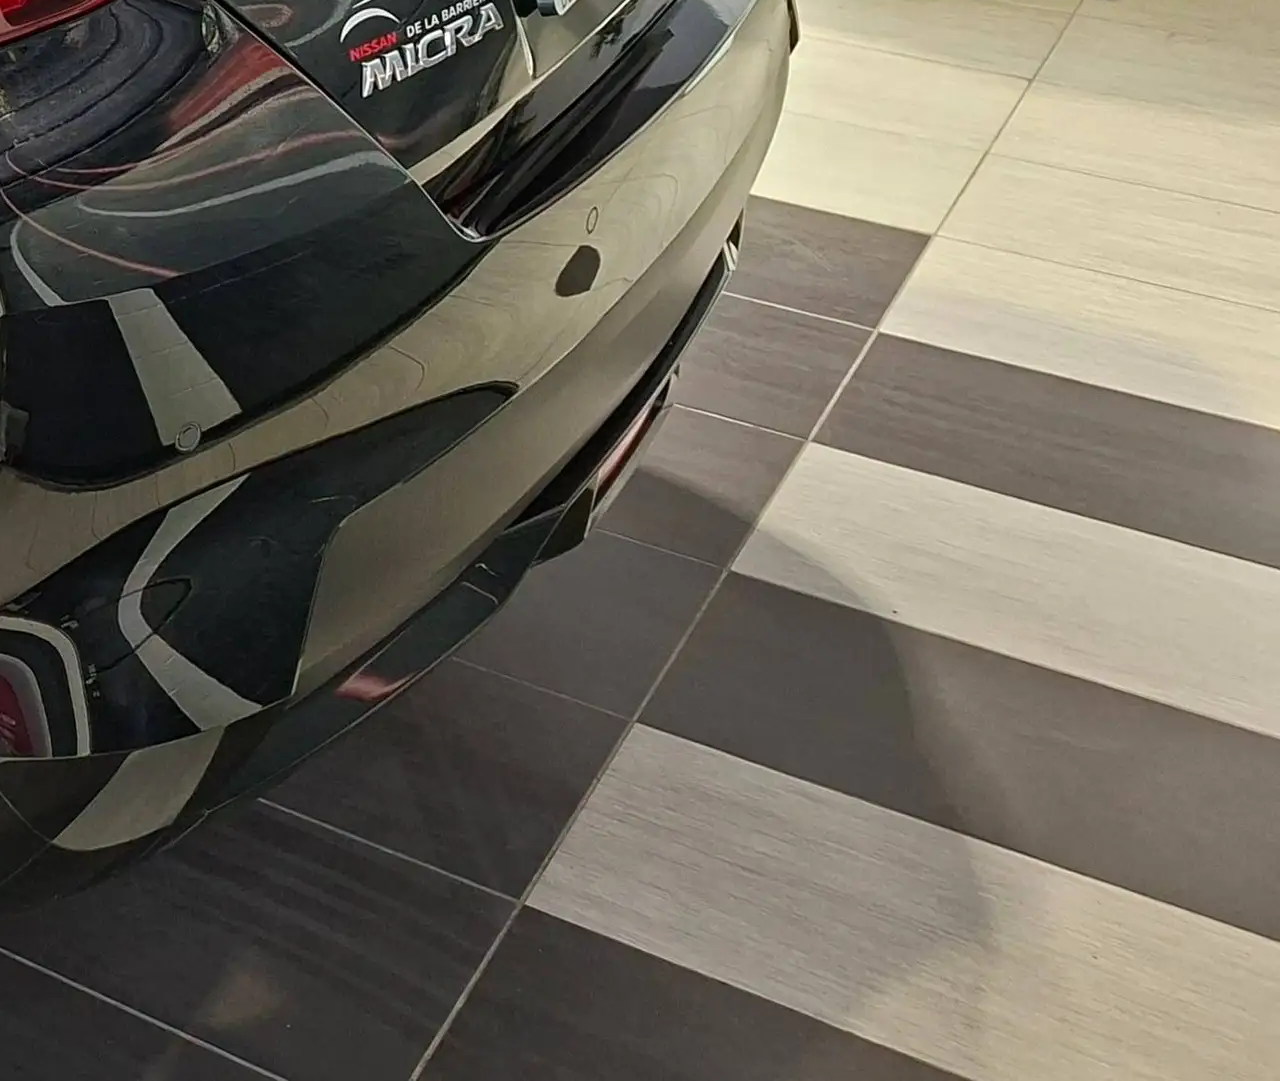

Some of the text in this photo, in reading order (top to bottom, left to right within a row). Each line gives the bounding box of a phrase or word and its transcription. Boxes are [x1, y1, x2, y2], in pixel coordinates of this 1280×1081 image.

[349, 31, 397, 62] NISSAN
[406, 24, 422, 39] DE
[424, 14, 439, 30] LA
[361, 2, 504, 98] MICRA
